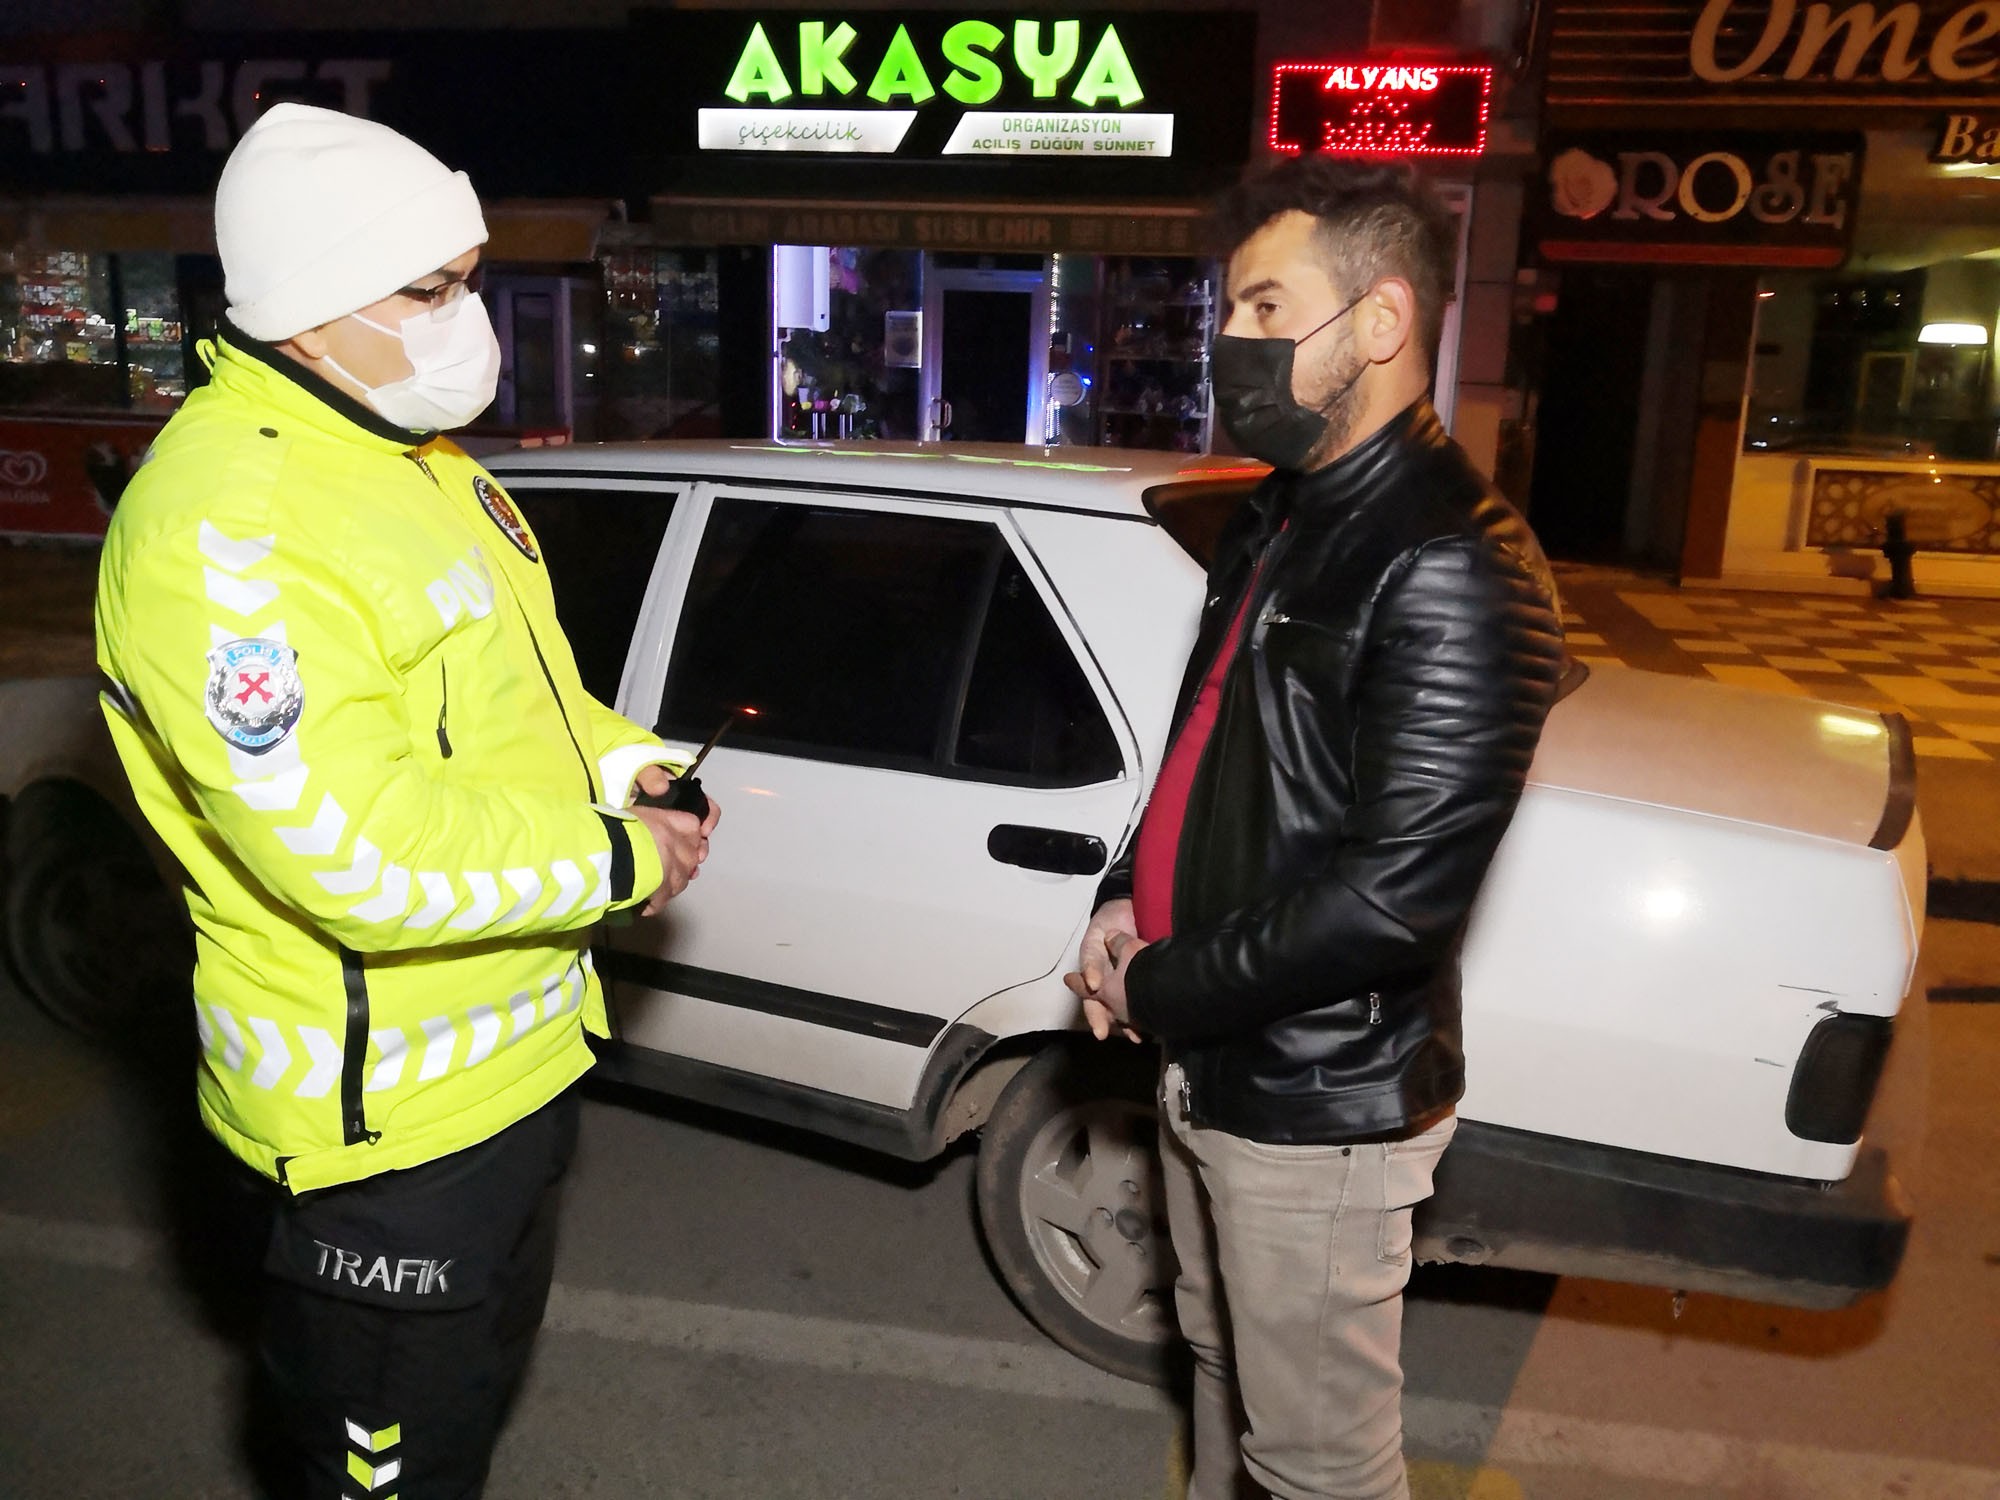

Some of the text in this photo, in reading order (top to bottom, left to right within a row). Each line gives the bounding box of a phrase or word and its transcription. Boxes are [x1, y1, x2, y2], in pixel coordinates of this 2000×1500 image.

[724, 19, 1145, 107] AKASYA
[1325, 66, 1438, 91] ALYANS
[738, 120, 863, 146] çiçekcilik
[1093, 138, 1156, 152] SÜNNET
[1611, 149, 1856, 230] ROSE
